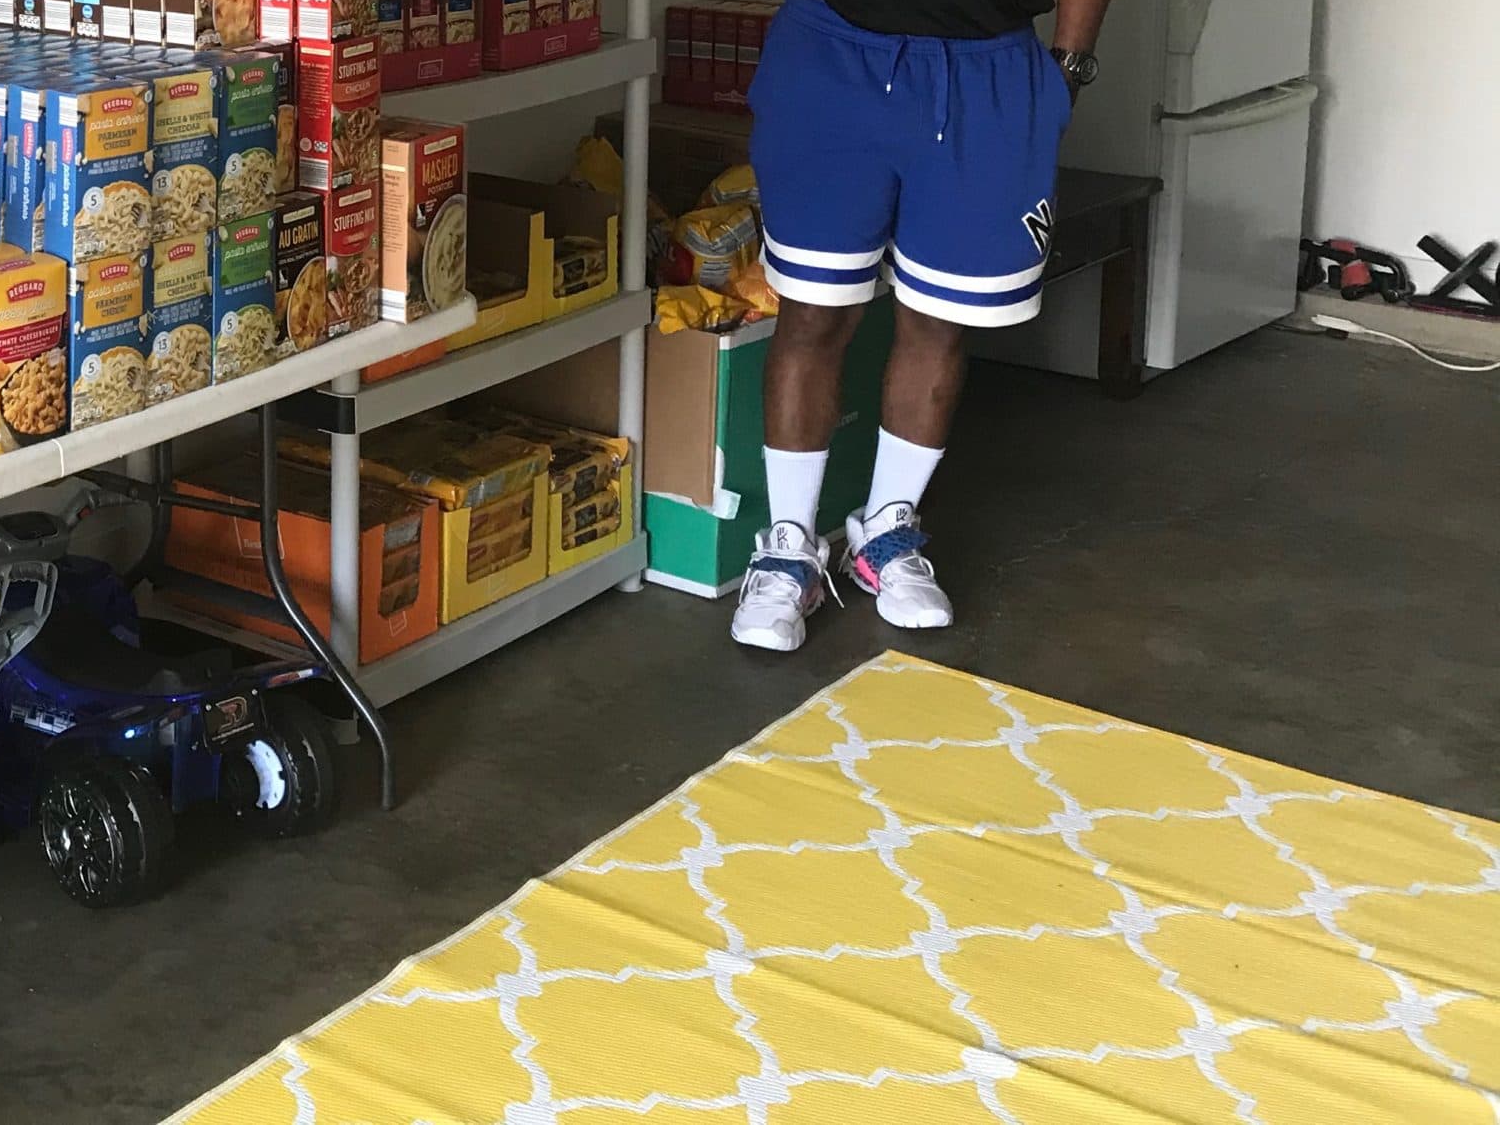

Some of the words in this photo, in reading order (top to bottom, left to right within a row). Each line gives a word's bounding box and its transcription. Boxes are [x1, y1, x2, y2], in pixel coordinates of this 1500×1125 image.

[338, 62, 365, 80] STUFFING
[170, 85, 198, 97] REGGANO
[102, 99, 133, 110] REGGANO
[232, 162, 238, 172] 5
[422, 154, 459, 186] MASHED
[156, 177, 167, 188] 13
[91, 196, 97, 206] 5
[333, 209, 365, 233] STUFFING
[365, 206, 376, 224] MIX
[278, 231, 291, 249] AU
[292, 224, 320, 245] GRATIN
[101, 266, 129, 278] REGGANO
[9, 281, 43, 298] REGGANO
[227, 318, 233, 330] 5
[19, 325, 59, 343] CHEESEBURGER
[158, 338, 167, 350] 13
[88, 363, 95, 374] 5
